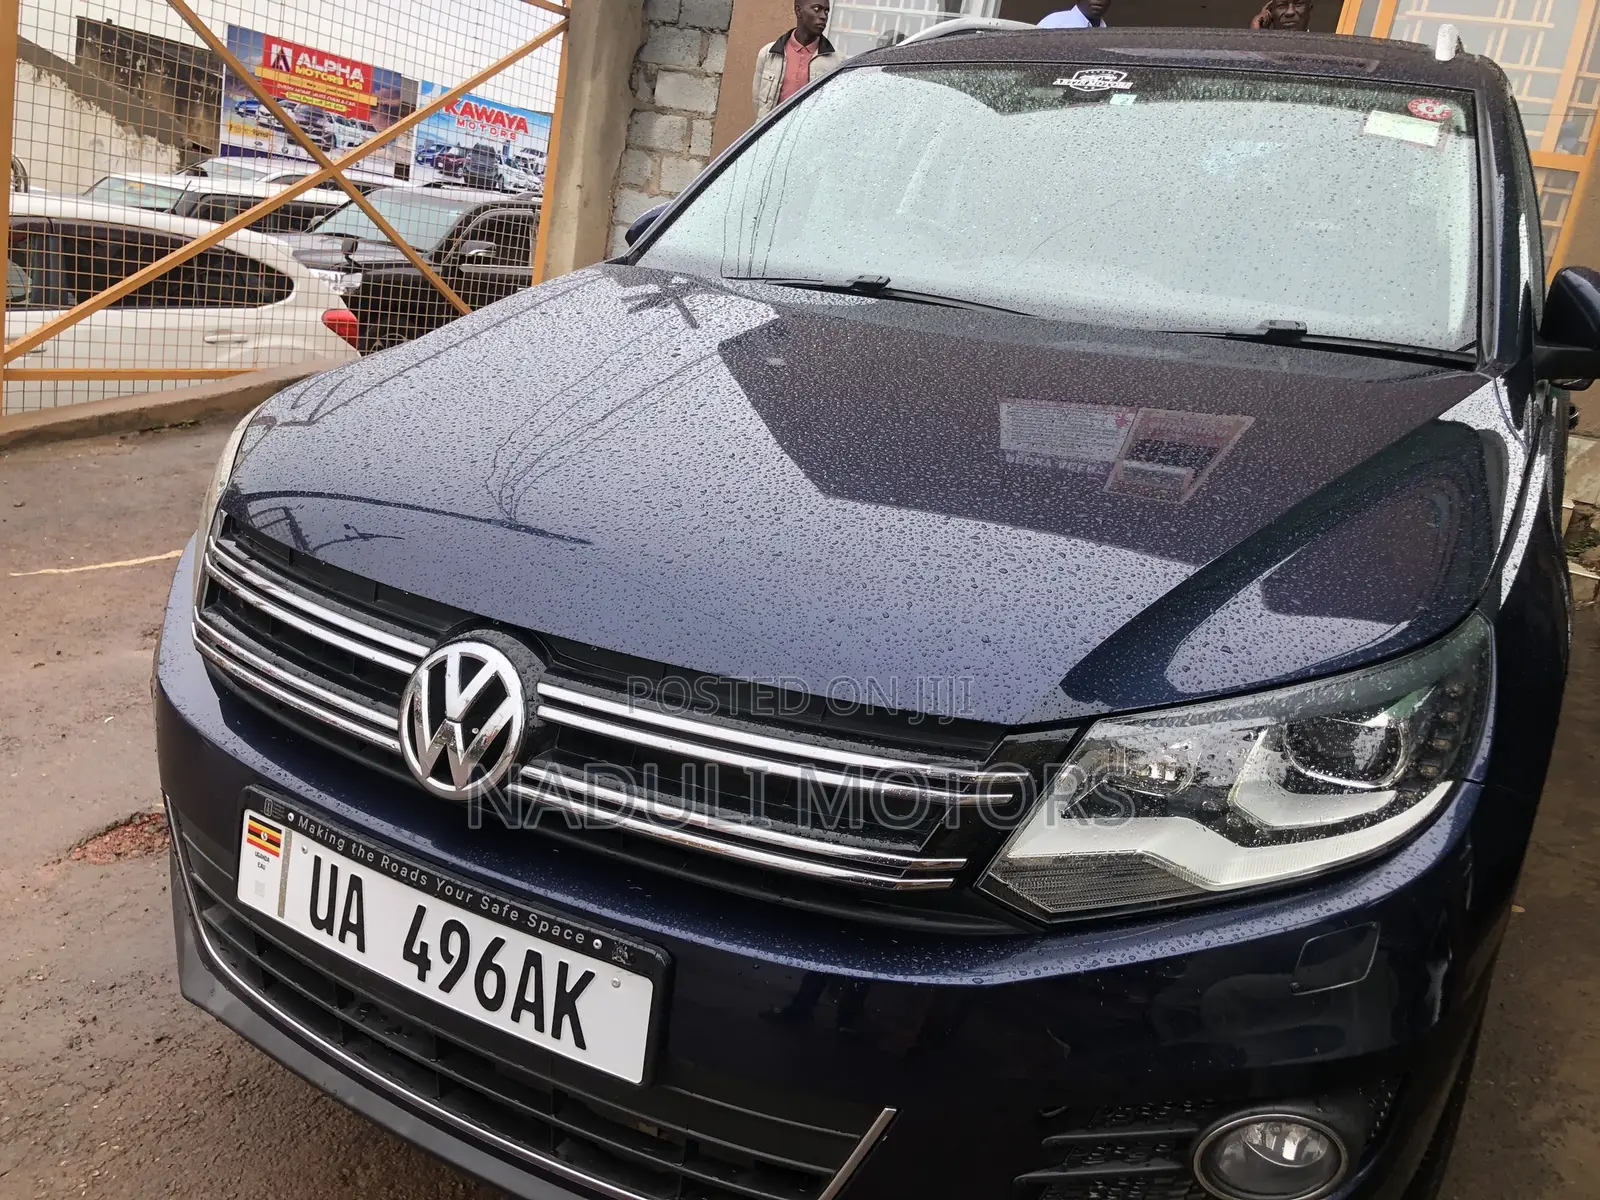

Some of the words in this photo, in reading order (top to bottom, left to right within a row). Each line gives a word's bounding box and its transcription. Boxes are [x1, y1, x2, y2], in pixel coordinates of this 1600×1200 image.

[295, 66, 344, 86] MOTORS
[296, 52, 364, 83] ALPHA
[444, 98, 529, 134] KAWAYA
[456, 118, 517, 141] MOTORS
[254, 850, 271, 863] UGANDA
[298, 815, 346, 852] Making
[351, 842, 375, 862] the
[380, 855, 428, 886] Roads
[435, 878, 473, 903] Your
[480, 895, 519, 922] Safe
[527, 913, 585, 944] Space
[309, 854, 367, 954] UA
[402, 904, 596, 1051] 496AK
